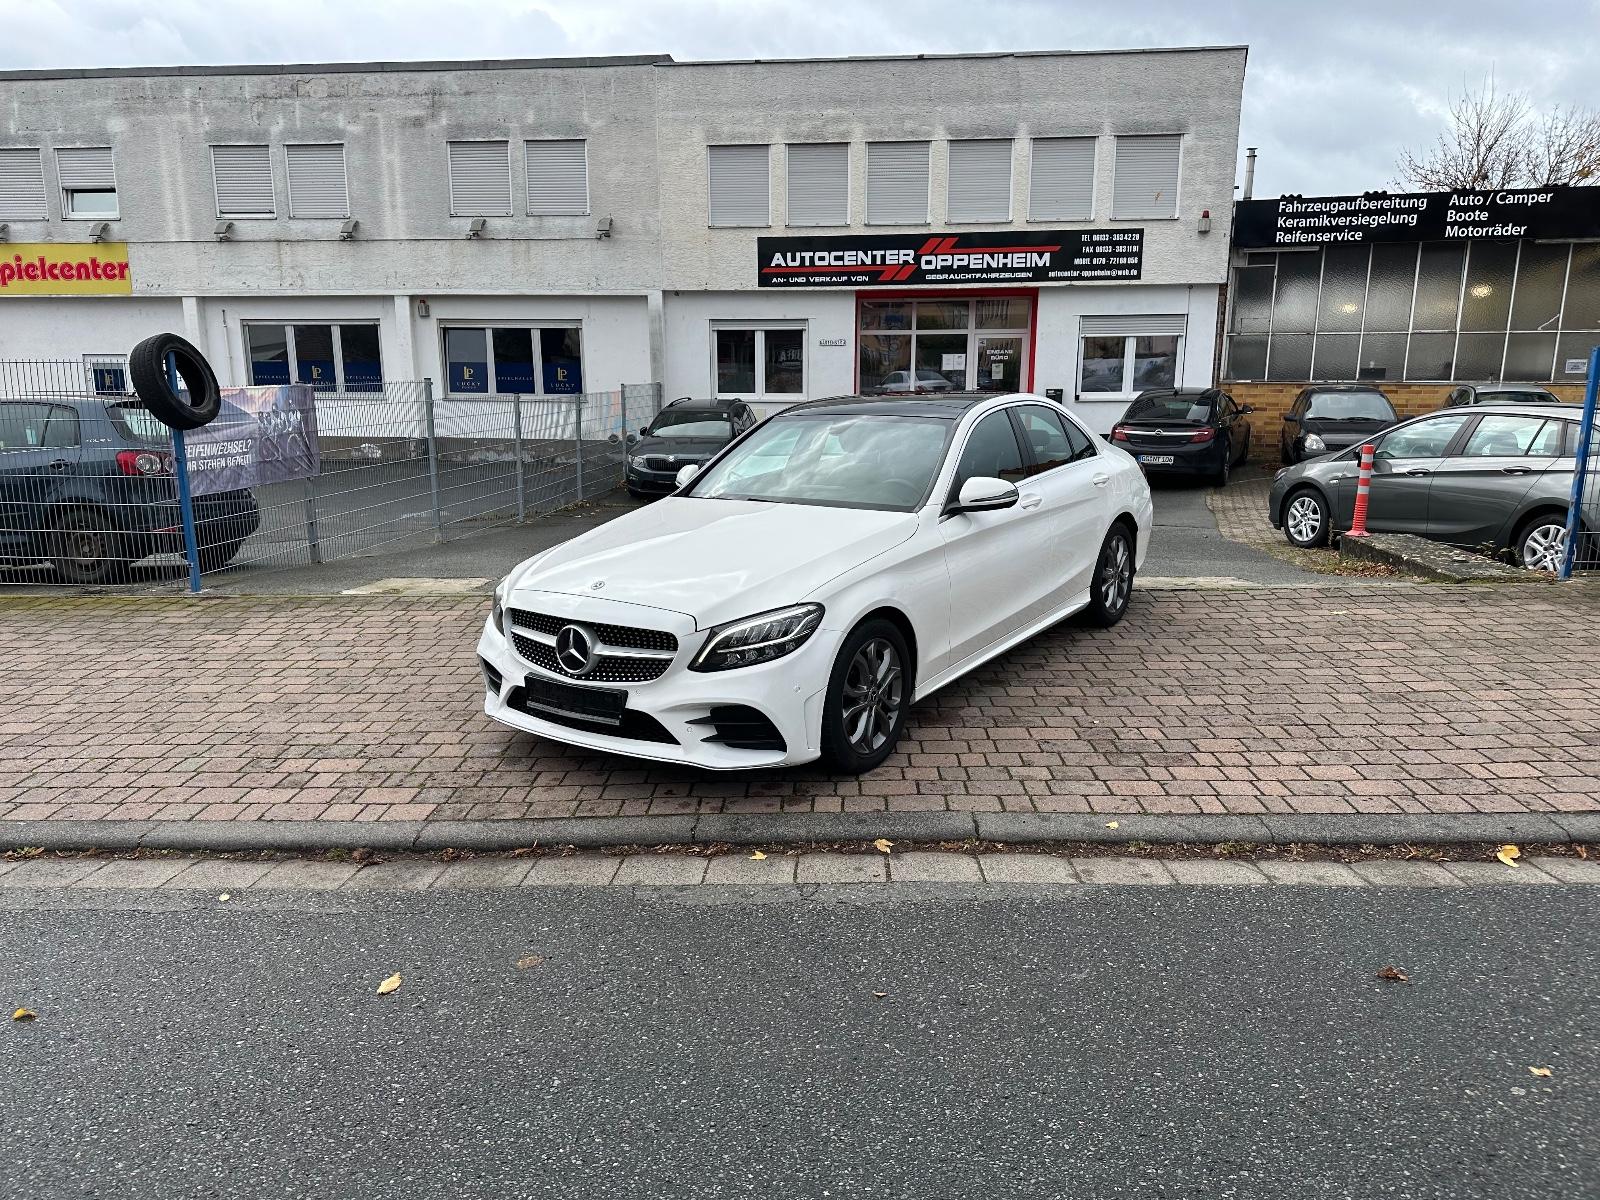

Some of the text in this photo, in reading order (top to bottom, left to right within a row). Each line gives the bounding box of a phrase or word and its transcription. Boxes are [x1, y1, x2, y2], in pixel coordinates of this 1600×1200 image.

[1278, 197, 1428, 214] Fahrzeugaufbereitung
[1449, 192, 1554, 206] Auto / Camper
[1277, 212, 1418, 228] Keramikversiegelung
[1446, 209, 1489, 222] Boote
[1275, 229, 1363, 243] Reifenservice
[1444, 223, 1528, 238] Motorräder
[770, 250, 915, 267] AUTOCENTER
[920, 252, 1051, 270] OPPENHEIM
[1073, 257, 1091, 265] MOBIL
[0, 254, 129, 287] pielcenter
[926, 272, 1033, 280] GEBRAUCHTFAHRZEUGEN
[184, 439, 252, 458] EIFENWECHSEL?
